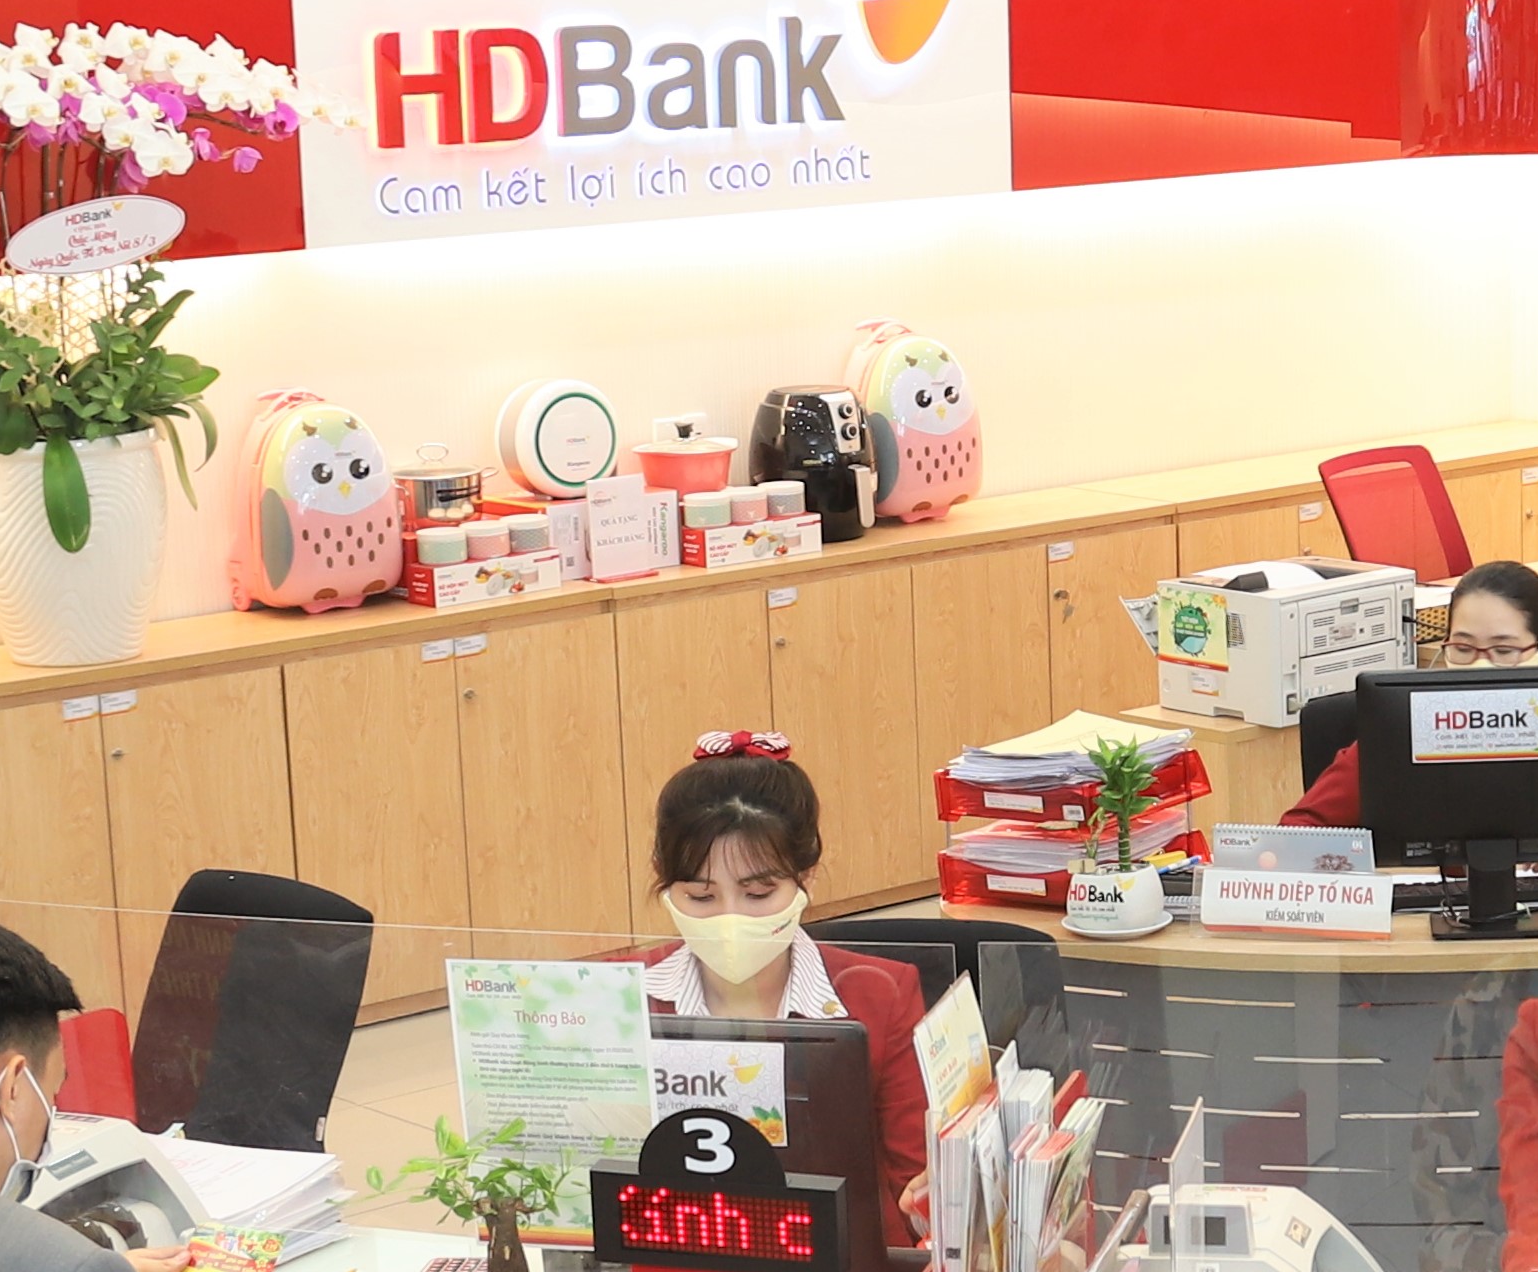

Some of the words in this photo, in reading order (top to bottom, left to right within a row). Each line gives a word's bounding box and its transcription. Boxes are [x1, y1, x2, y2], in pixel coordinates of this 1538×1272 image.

[373, 16, 846, 149] HDBank
[378, 175, 462, 215] Cam
[485, 169, 548, 207] kết
[567, 164, 616, 208] lợi
[638, 157, 688, 199] ích
[708, 160, 772, 190] cao
[792, 144, 872, 186] nhất
[65, 209, 112, 226] HDBank
[1435, 709, 1528, 730] HDBank
[1220, 837, 1251, 846] HDBank
[1069, 884, 1124, 903] HDBank
[1220, 878, 1274, 900] HUỲNH
[1279, 881, 1314, 907] DIỆP
[1319, 879, 1339, 904] TỐ
[1341, 887, 1374, 905] NGA
[465, 980, 517, 993] HDBank
[513, 1010, 557, 1027] Thông
[561, 1011, 586, 1025] Báo
[655, 1068, 727, 1097] Bank
[682, 1118, 735, 1174] 3
